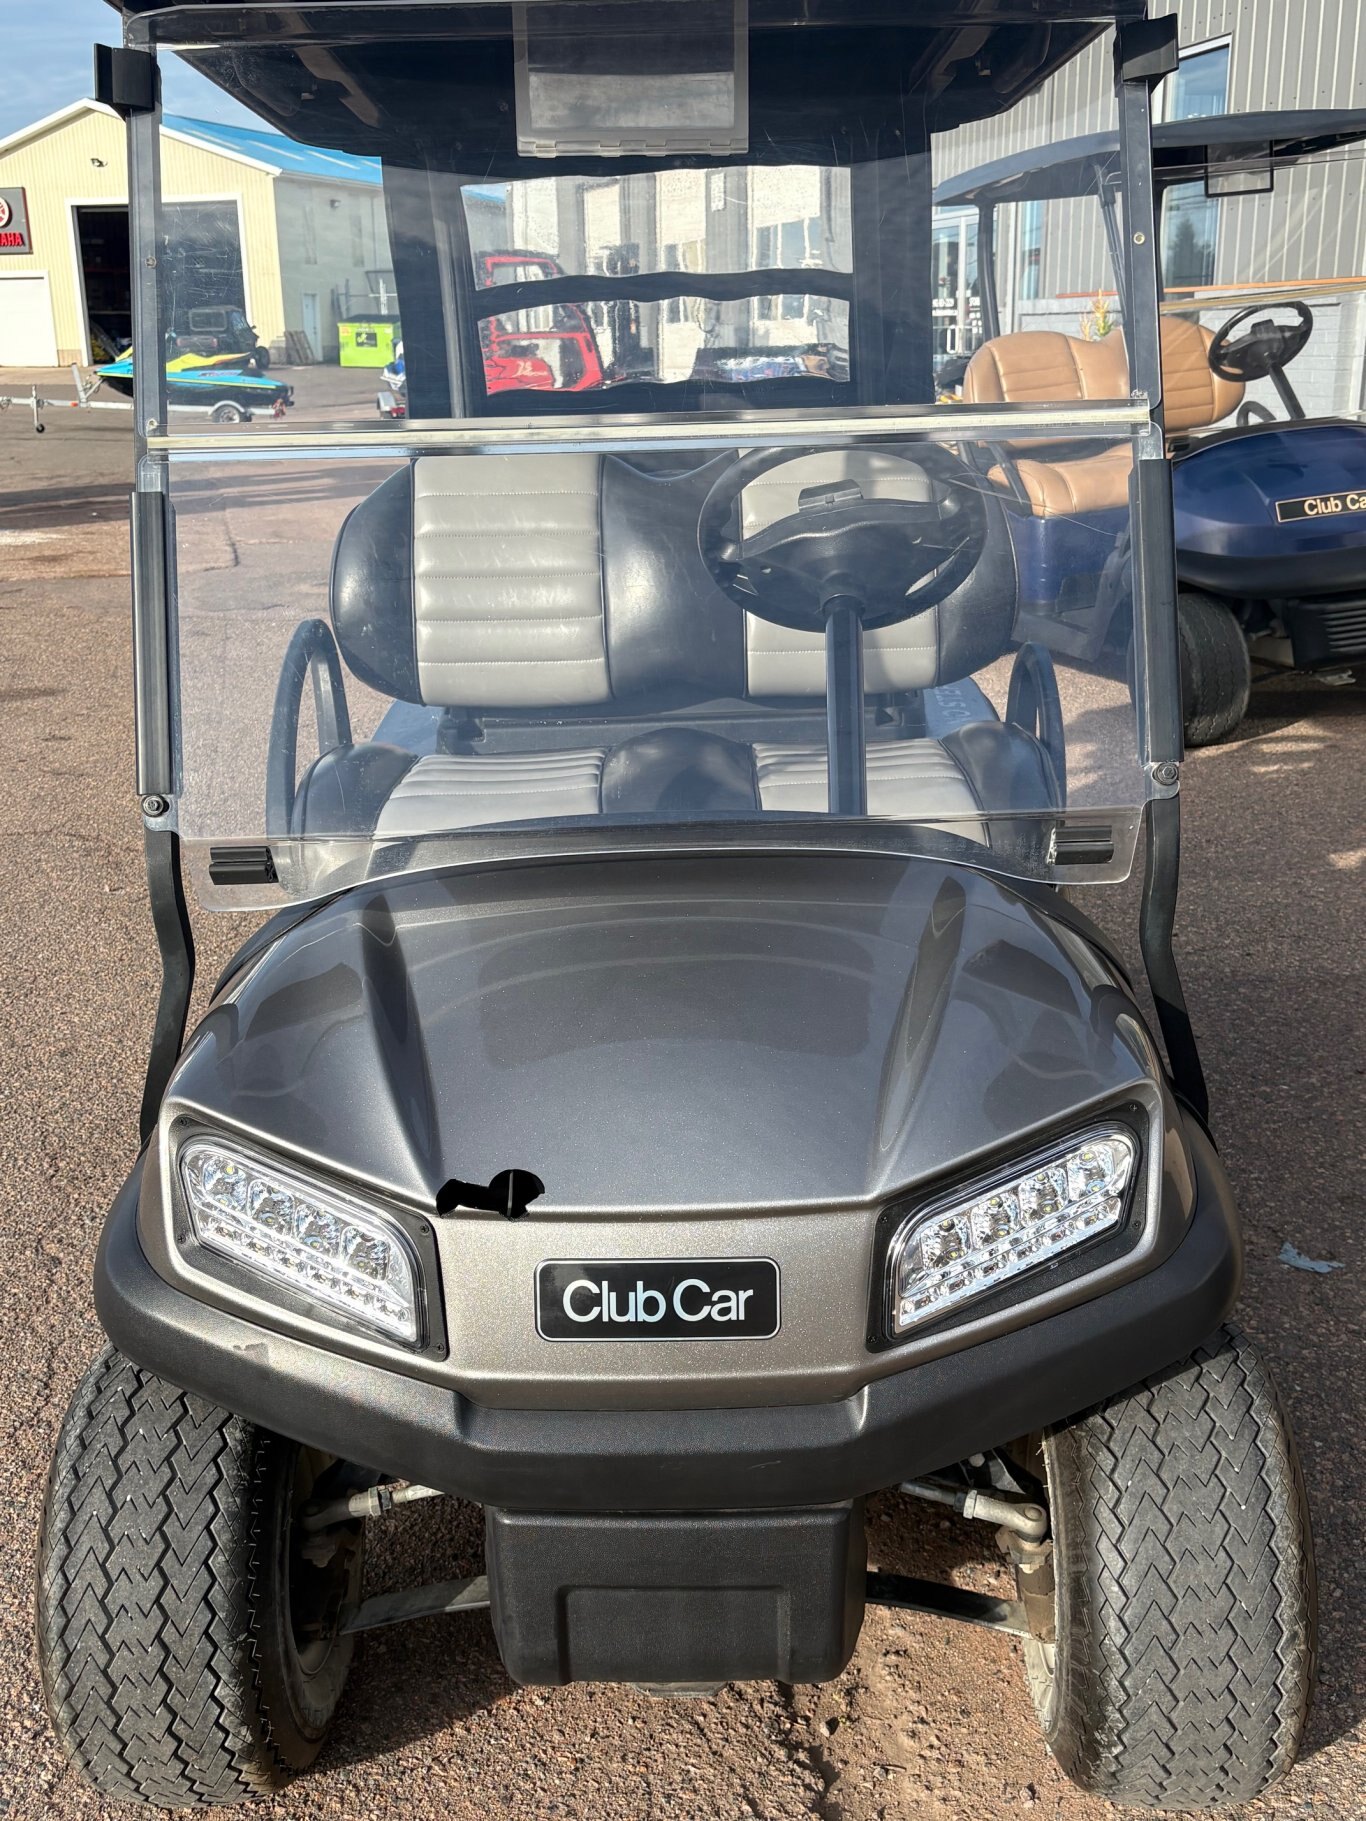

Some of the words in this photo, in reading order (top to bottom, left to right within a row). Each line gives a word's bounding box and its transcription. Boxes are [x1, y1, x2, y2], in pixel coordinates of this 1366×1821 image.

[1304, 496, 1343, 516] Club
[562, 1279, 667, 1323] Club
[672, 1278, 754, 1322] Car
